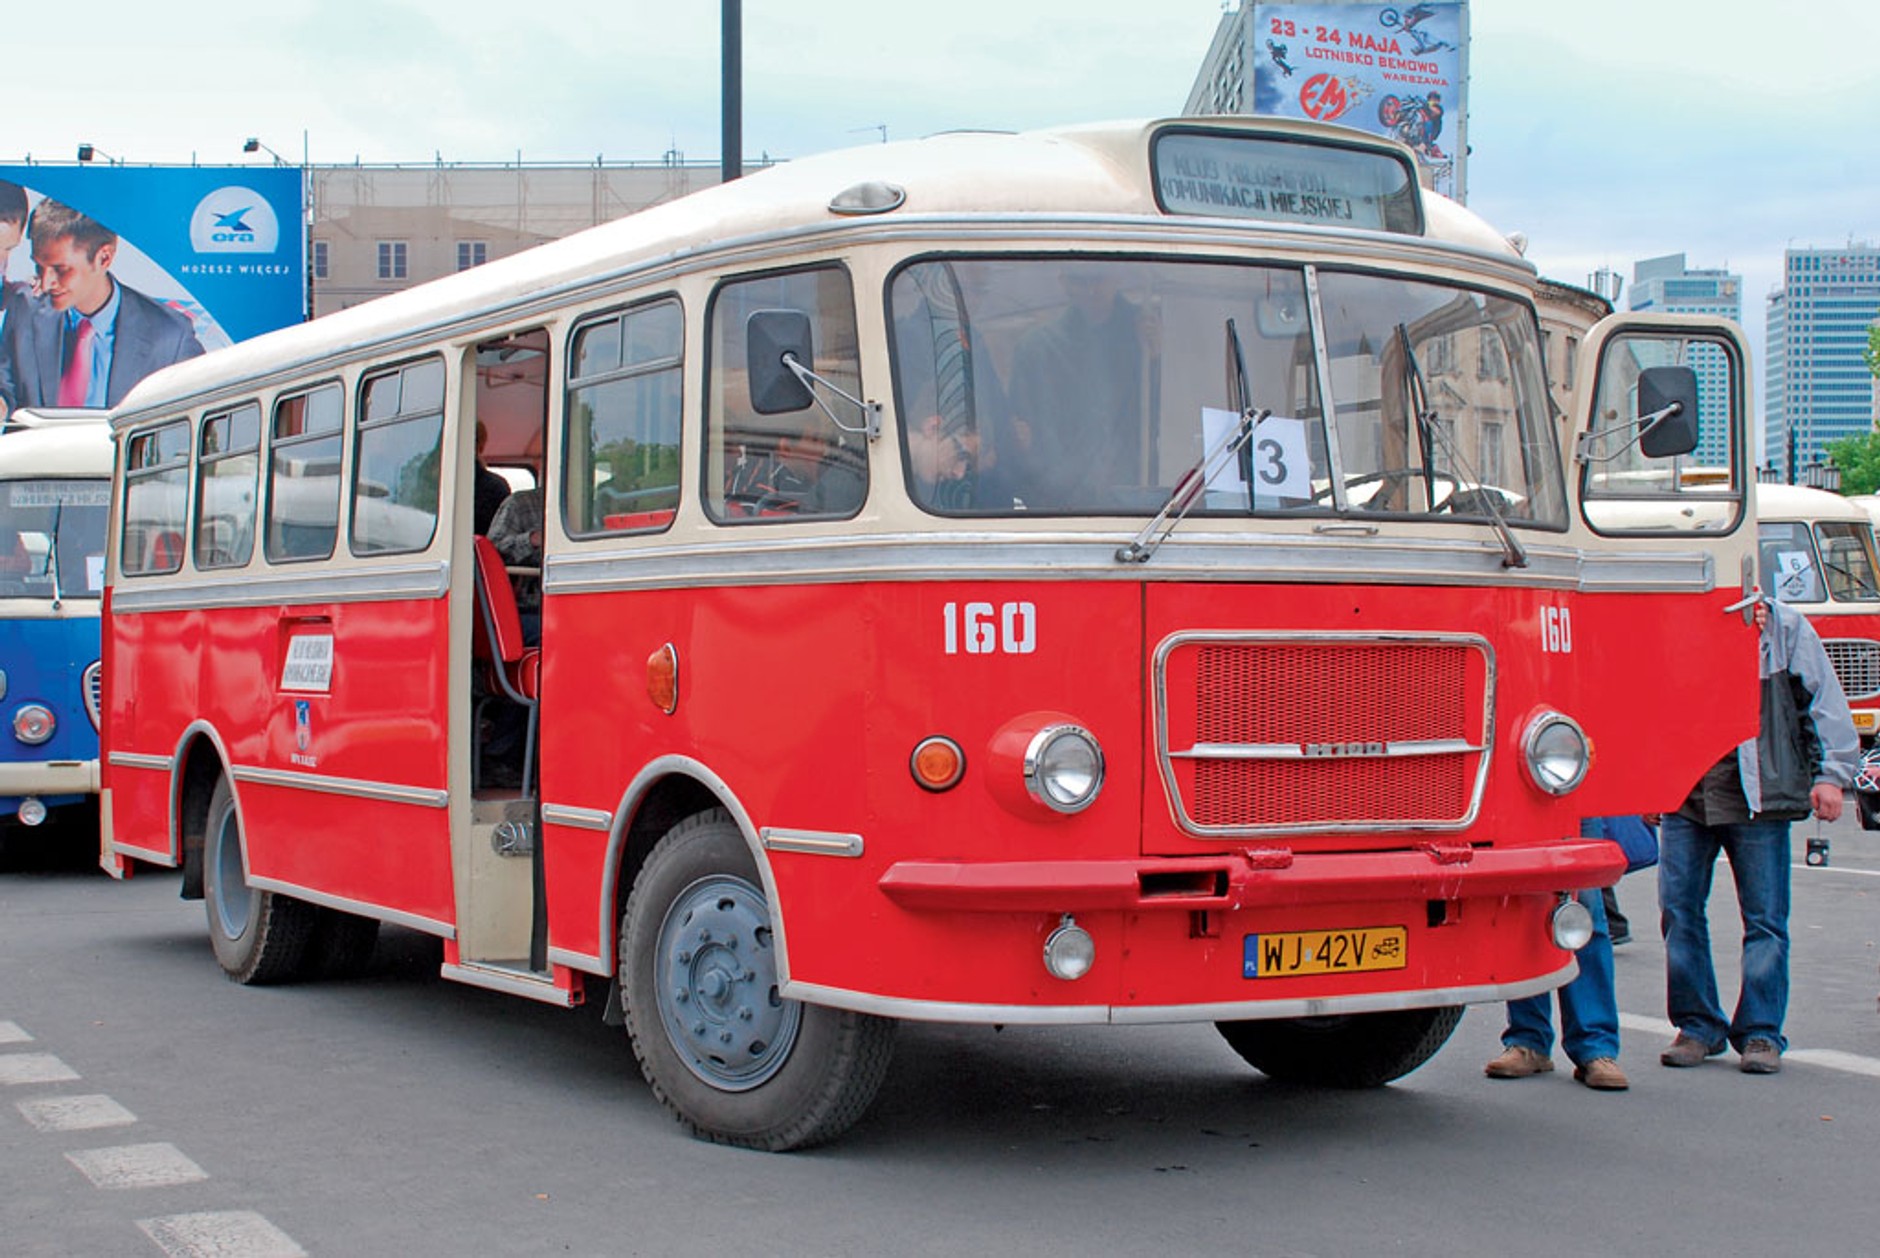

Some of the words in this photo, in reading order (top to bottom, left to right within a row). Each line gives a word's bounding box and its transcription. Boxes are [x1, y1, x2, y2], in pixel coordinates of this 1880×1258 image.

[1271, 18, 1296, 37] 23
[1316, 26, 1341, 45] 24
[1349, 31, 1403, 56] MAJA
[1305, 47, 1373, 66] LOTNISKO
[1378, 56, 1439, 75] BEMOWO
[1382, 71, 1449, 87] WARSZAWA
[1269, 190, 1353, 220] MIEJSKIEJ
[239, 264, 290, 276] WIĘCEJ
[943, 602, 1036, 654] 160
[1540, 605, 1572, 653] 160
[1245, 961, 1257, 971] PL
[1264, 937, 1303, 972] WJ
[1315, 932, 1367, 968] 42V
